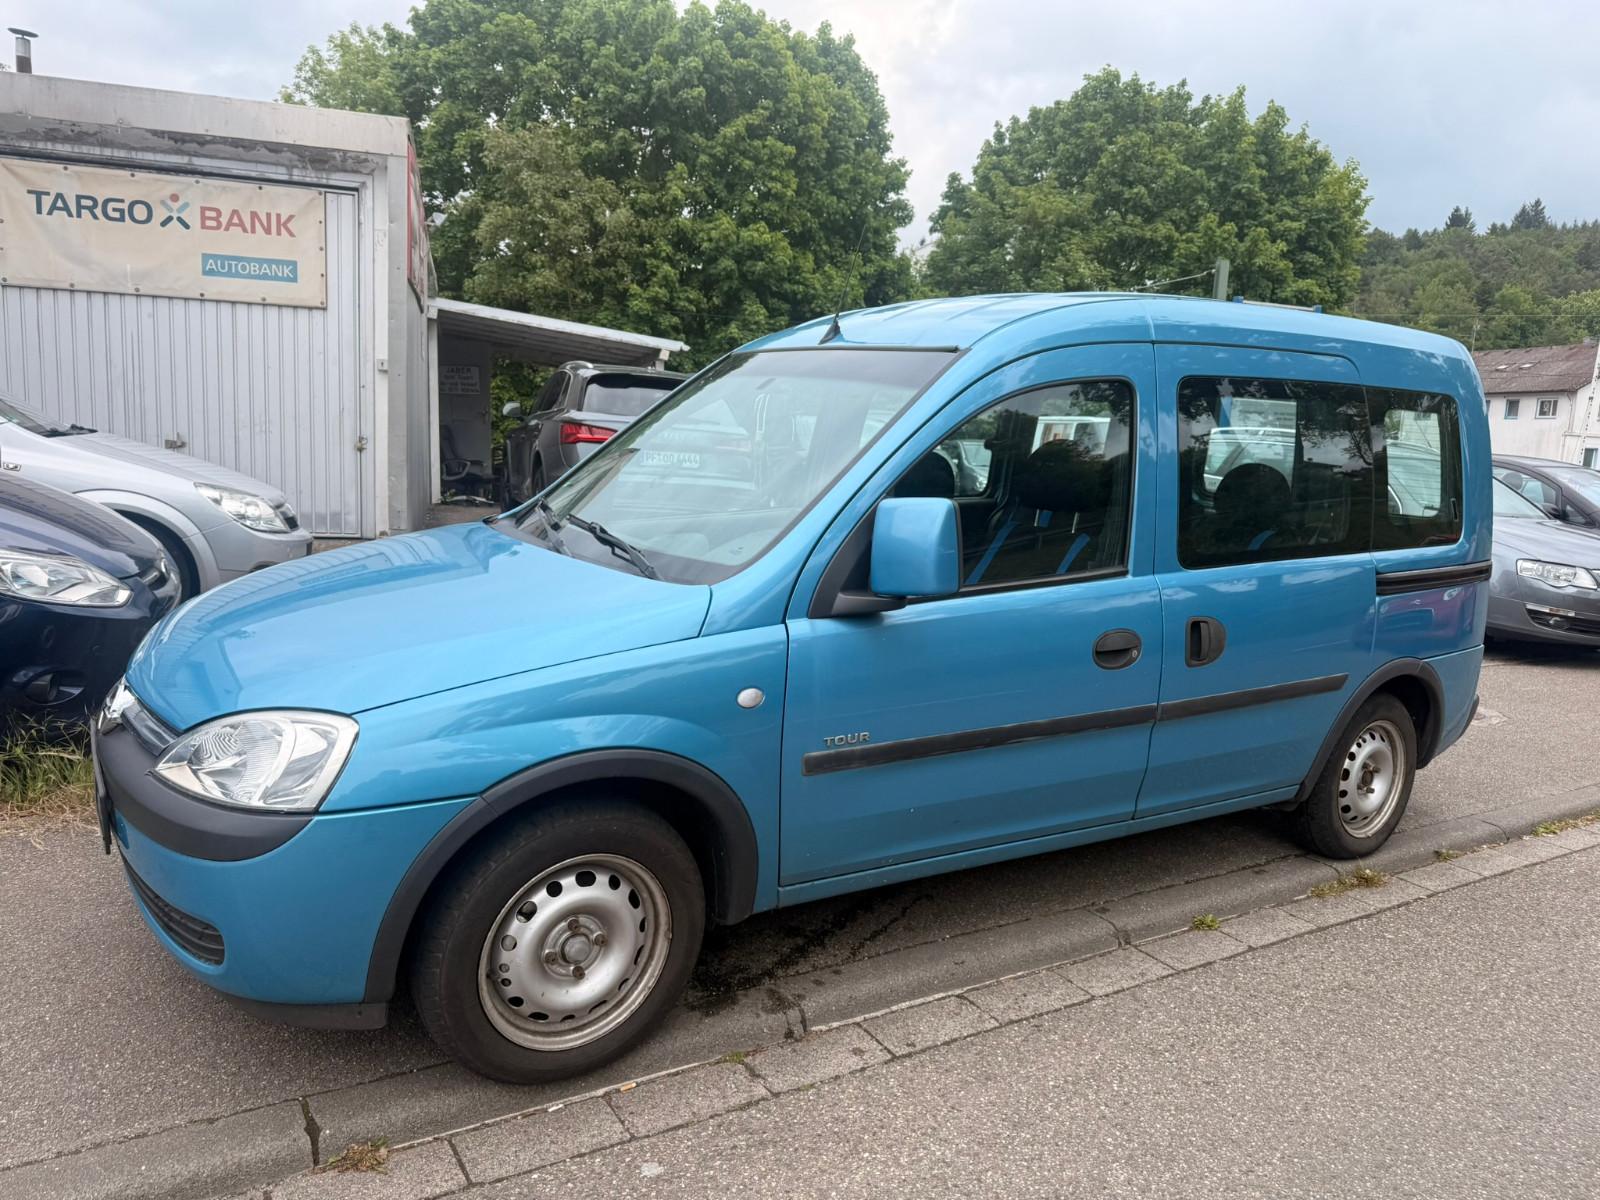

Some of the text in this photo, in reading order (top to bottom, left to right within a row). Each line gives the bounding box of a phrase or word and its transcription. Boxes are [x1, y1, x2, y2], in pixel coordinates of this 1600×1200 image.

[27, 189, 297, 238] TARGO BANK
[205, 259, 294, 279] AUTOBANK
[823, 731, 870, 746] TOUR
